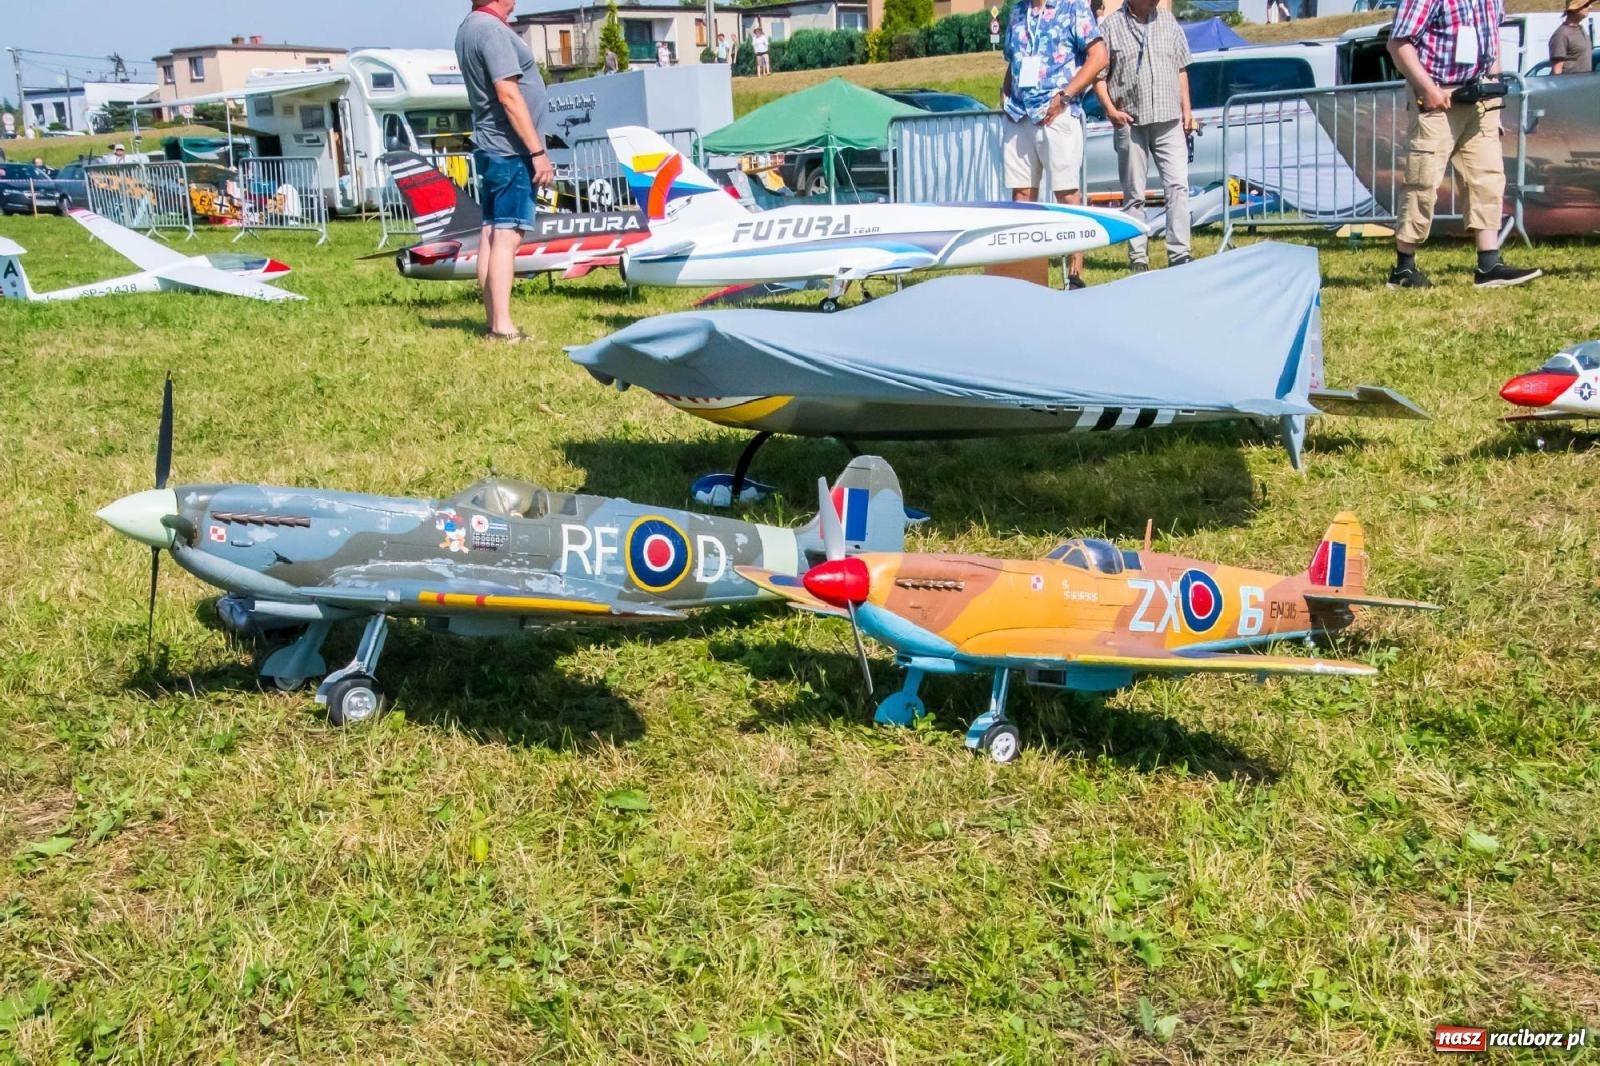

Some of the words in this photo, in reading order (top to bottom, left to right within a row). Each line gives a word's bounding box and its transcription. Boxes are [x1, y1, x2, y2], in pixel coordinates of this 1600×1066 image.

[541, 215, 641, 236] FUTURA
[732, 214, 851, 243] FUTURA
[987, 230, 1053, 246] JETPOL
[3, 260, 19, 279] A
[560, 523, 620, 576] RF
[695, 534, 727, 584] D
[1127, 578, 1182, 634] ZX
[1237, 585, 1266, 636] 6
